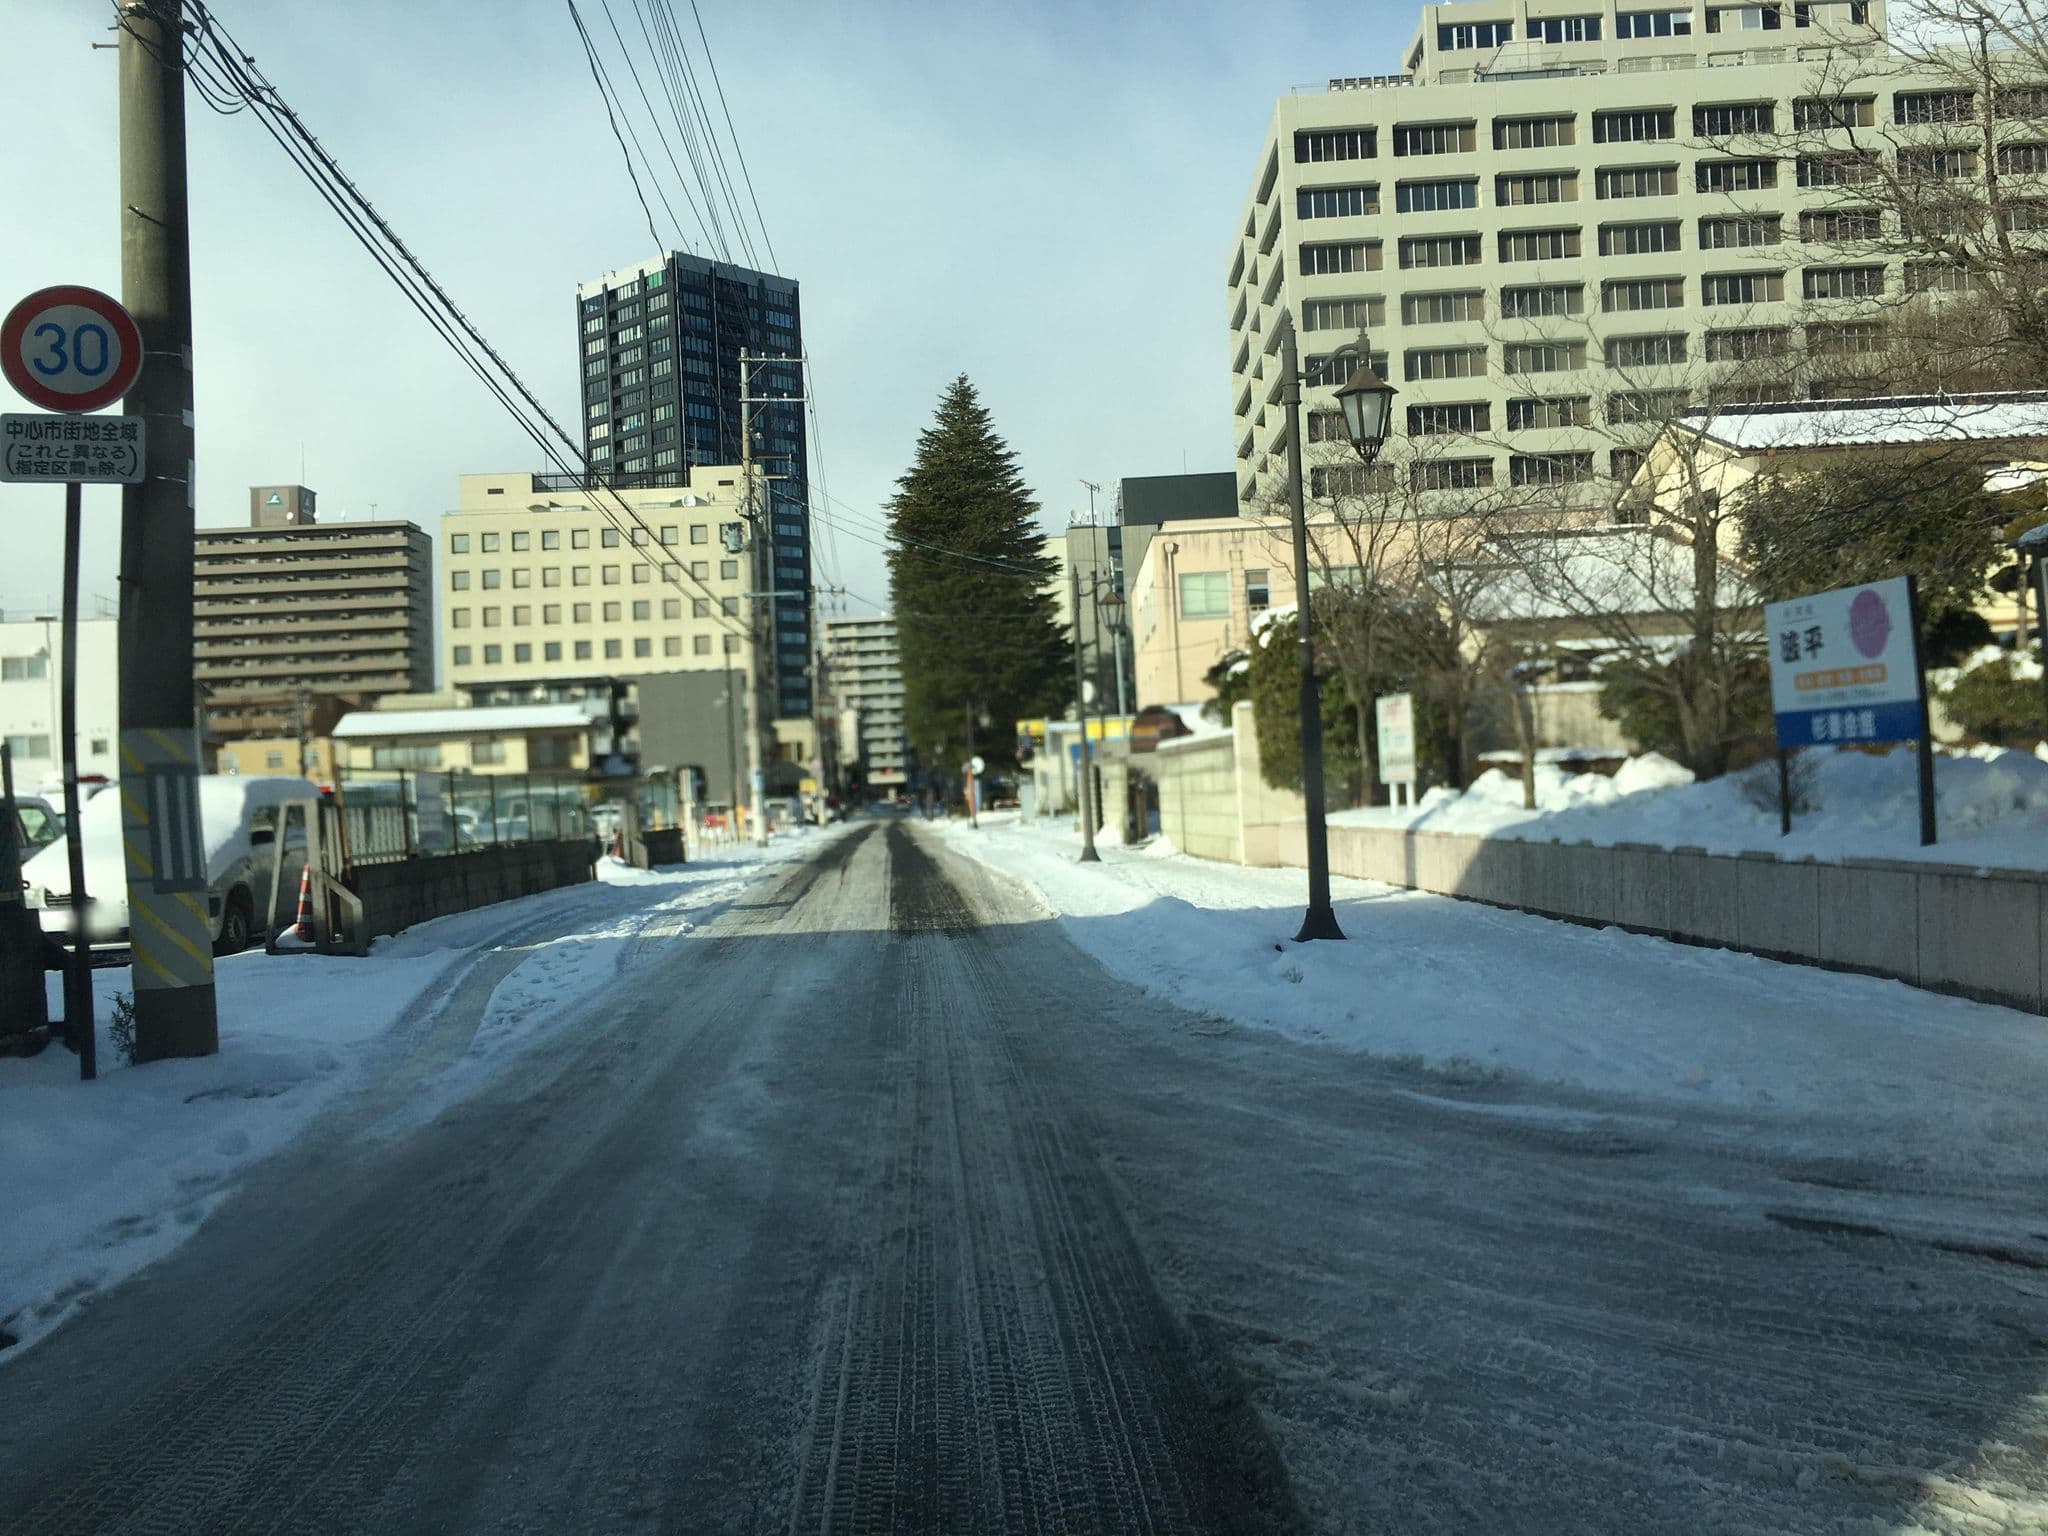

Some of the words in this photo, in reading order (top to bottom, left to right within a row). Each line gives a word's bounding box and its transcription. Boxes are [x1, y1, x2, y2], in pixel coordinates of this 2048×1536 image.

[33, 322, 109, 377] 30
[6, 420, 138, 442] 中心市街地全域
